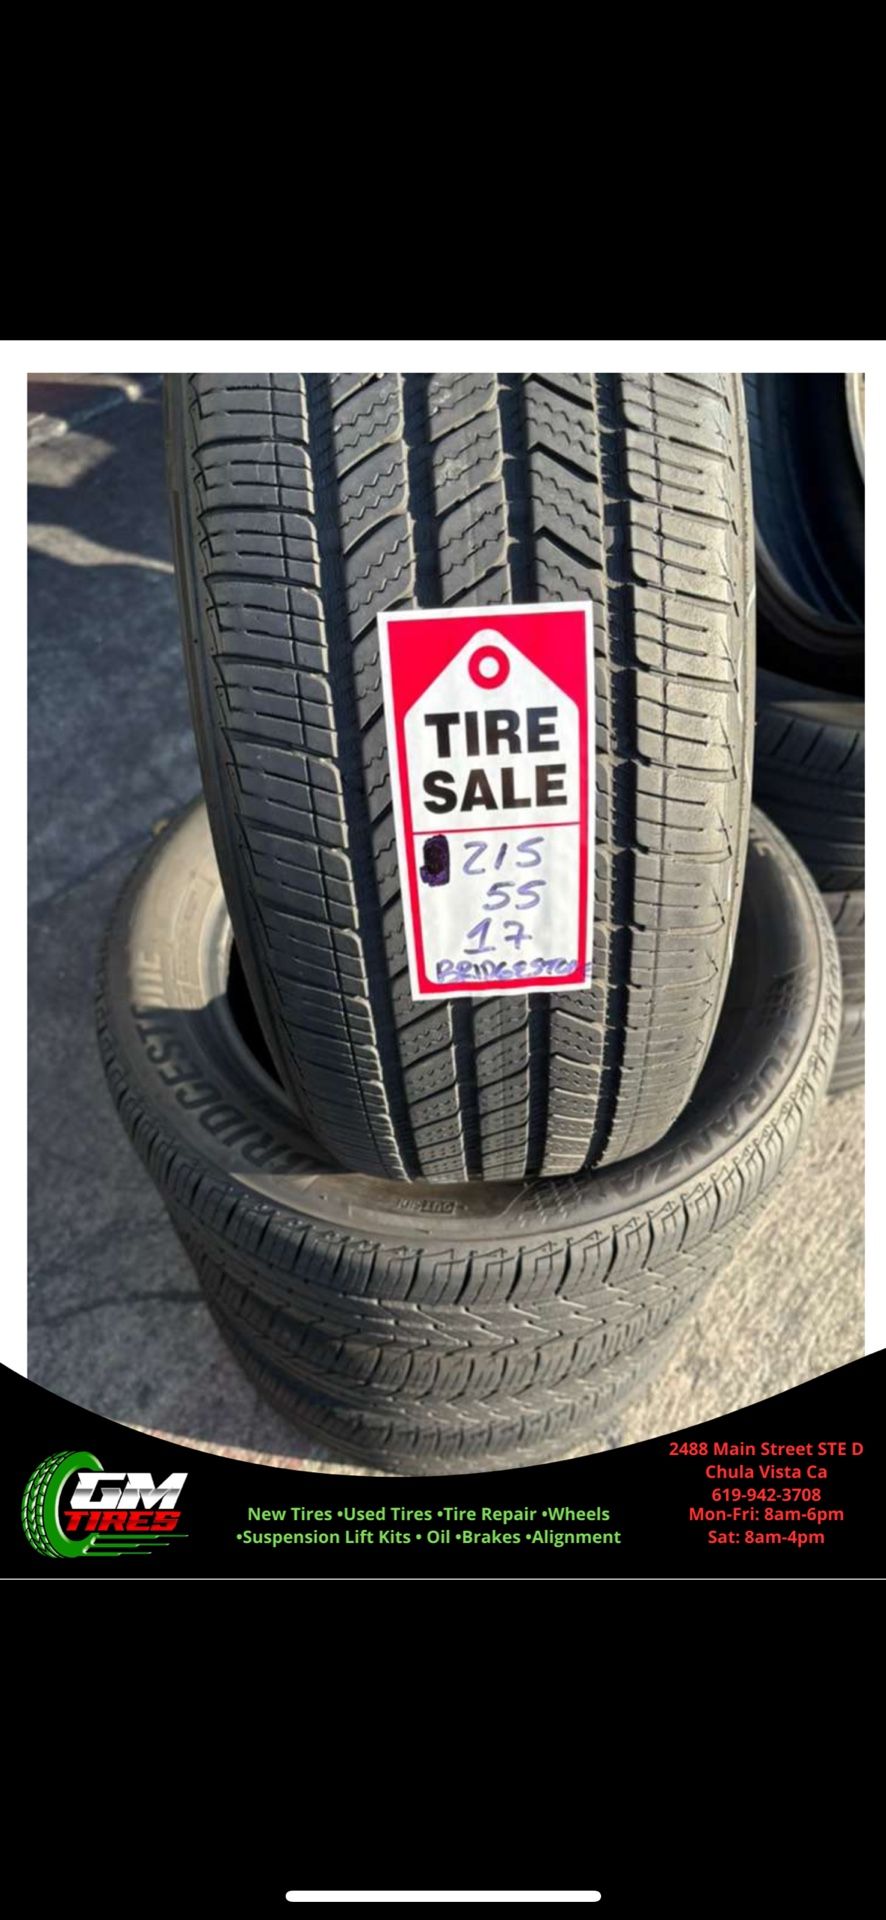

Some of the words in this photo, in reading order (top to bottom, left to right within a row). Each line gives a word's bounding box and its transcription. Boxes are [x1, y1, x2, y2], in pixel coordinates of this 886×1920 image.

[424, 706, 560, 758] TIRE
[422, 764, 568, 814] SALE
[463, 837, 545, 875] 215
[482, 880, 547, 910] 55
[463, 917, 532, 955] 17
[616, 1035, 800, 1198] TURANZA
